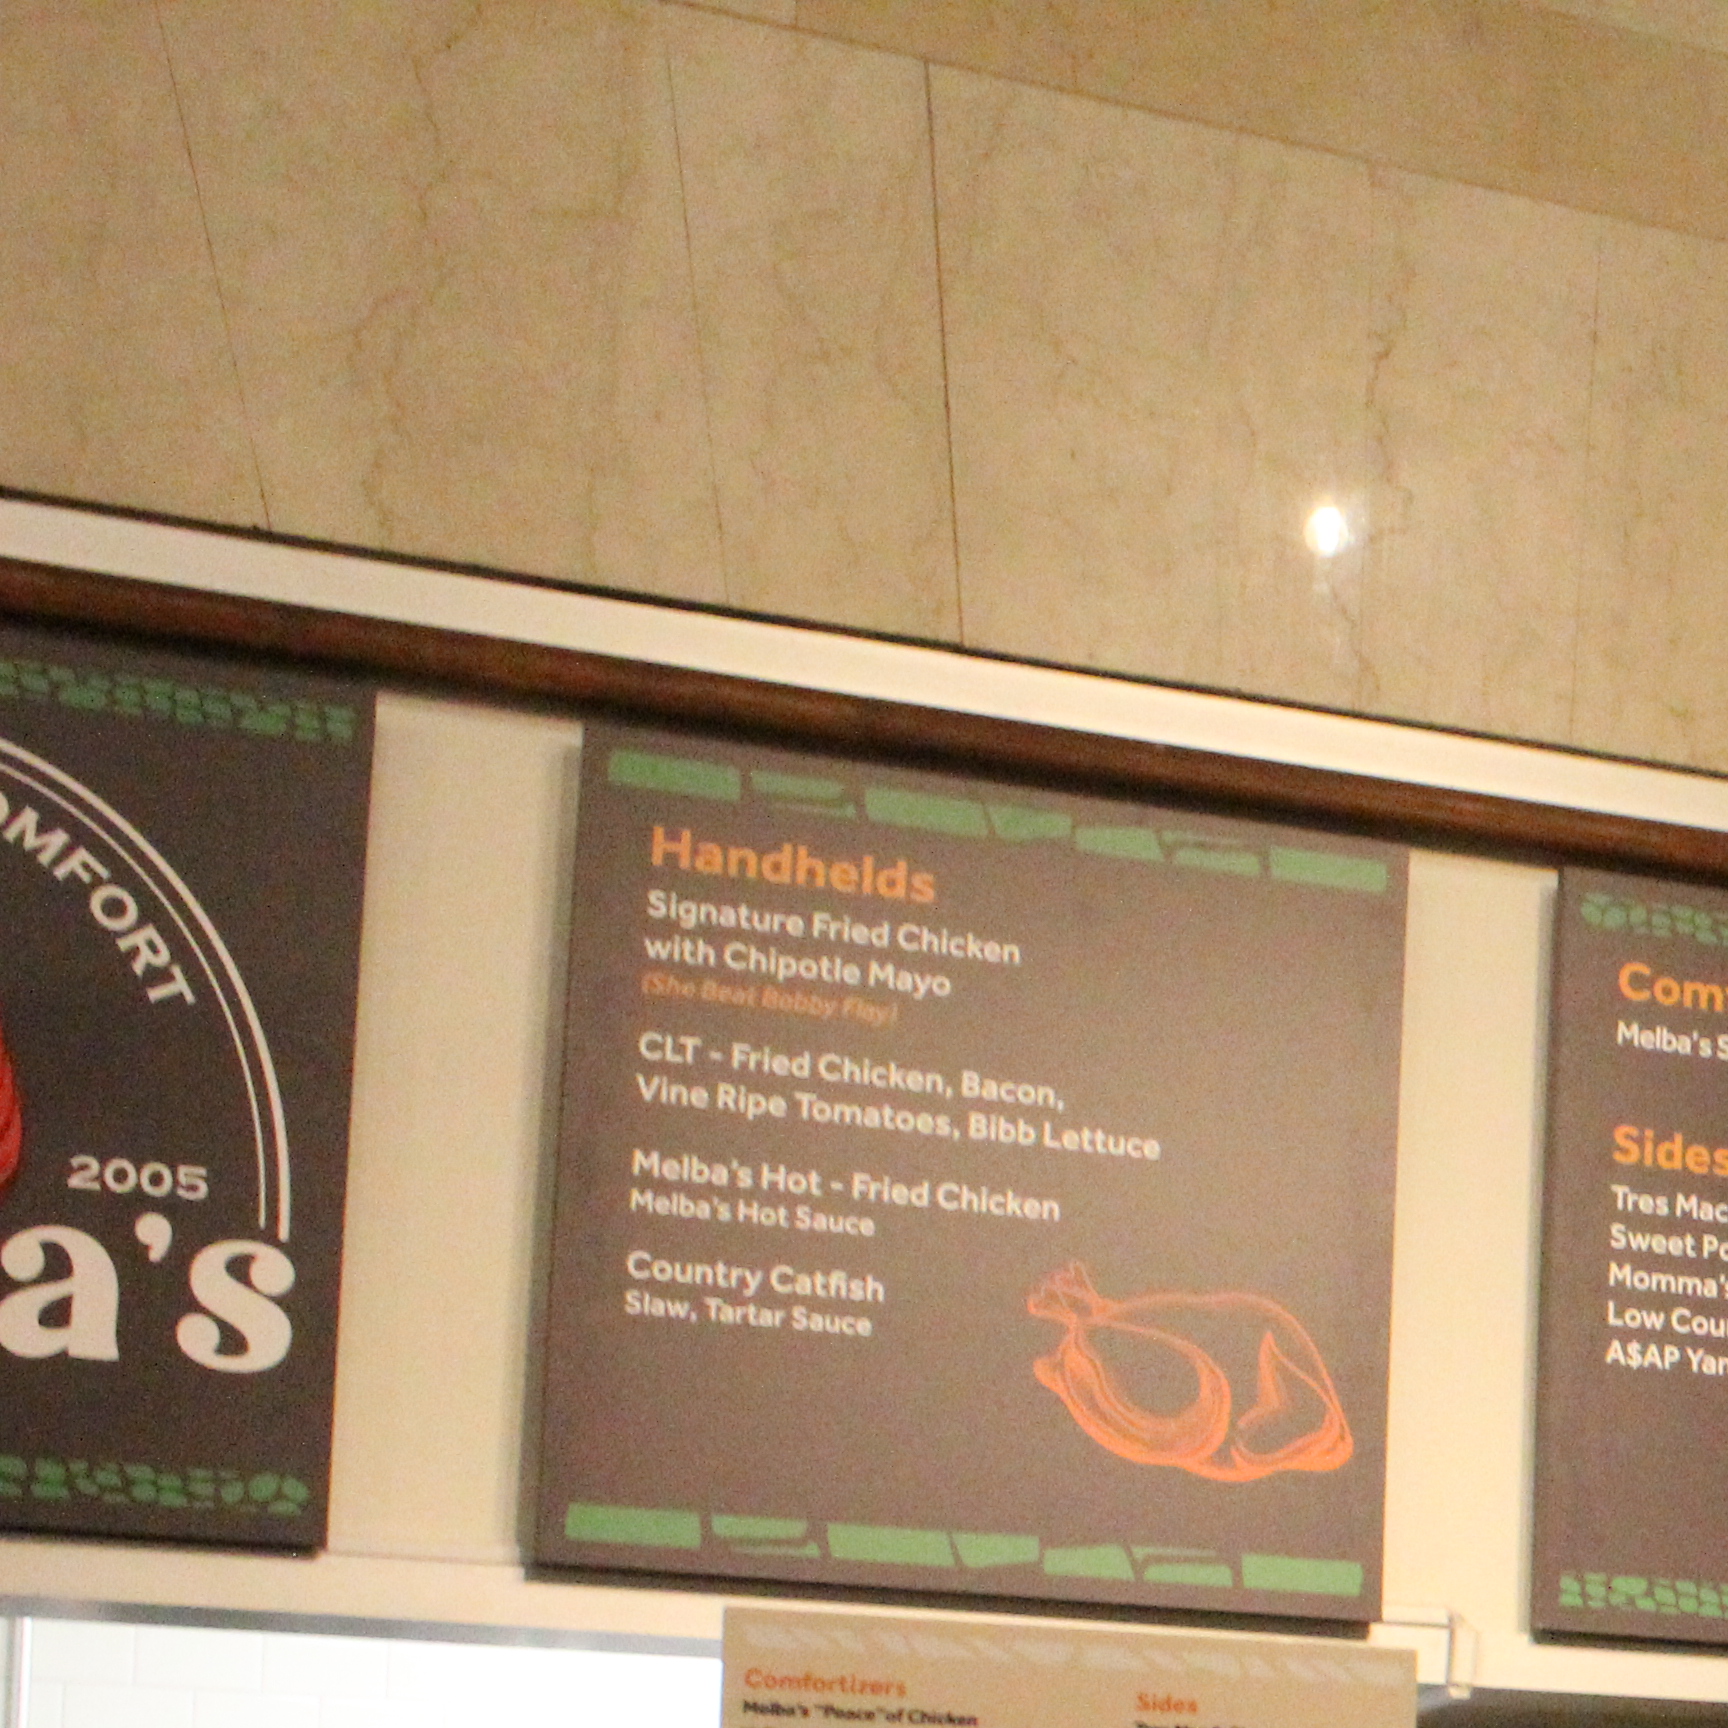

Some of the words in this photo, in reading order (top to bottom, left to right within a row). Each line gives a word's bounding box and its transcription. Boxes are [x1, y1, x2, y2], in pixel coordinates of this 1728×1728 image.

[652, 826, 935, 903] Handhelds
[0, 790, 195, 1005] MFORT
[647, 889, 805, 937] Signature
[811, 912, 891, 948] Fried
[896, 923, 1021, 965] Chicken
[644, 936, 716, 967] with
[723, 942, 861, 985] Chipotle
[868, 960, 952, 999] Mayo
[1616, 1021, 1713, 1058] Melba's
[638, 1032, 702, 1065] CLT
[731, 1042, 811, 1079] Fried
[817, 1053, 953, 1099] Chicken,
[960, 1069, 1065, 1113] Bacon,
[636, 1075, 709, 1109] Vine
[716, 1084, 788, 1121] Ripe
[794, 1092, 961, 1140] Tomatoes,
[968, 1111, 1037, 1146] Bibb
[1043, 1121, 1161, 1161] Lettuce
[67, 1153, 209, 1201] 2005
[632, 1149, 753, 1189] Melba's
[760, 1163, 822, 1197] Hot
[851, 1171, 930, 1207] Fried
[936, 1182, 1061, 1222] Chicken
[630, 1189, 731, 1221] Melba's
[737, 1199, 788, 1228] Hot
[795, 1205, 876, 1237] Sauce
[1611, 1185, 1669, 1216] Tres
[1675, 1193, 1728, 1224] Mac
[1610, 1224, 1697, 1258] Sweet
[626, 1250, 763, 1297] Country
[769, 1264, 885, 1303] Catfish
[625, 1290, 697, 1322] Slaw,
[704, 1297, 785, 1327] Tartar
[791, 1305, 873, 1337] Sauce
[1607, 1300, 1666, 1331] Low
[1605, 1339, 1681, 1370] A$AP
[745, 1669, 907, 1697] Comfortizers
[1138, 1694, 1198, 1714] Sides
